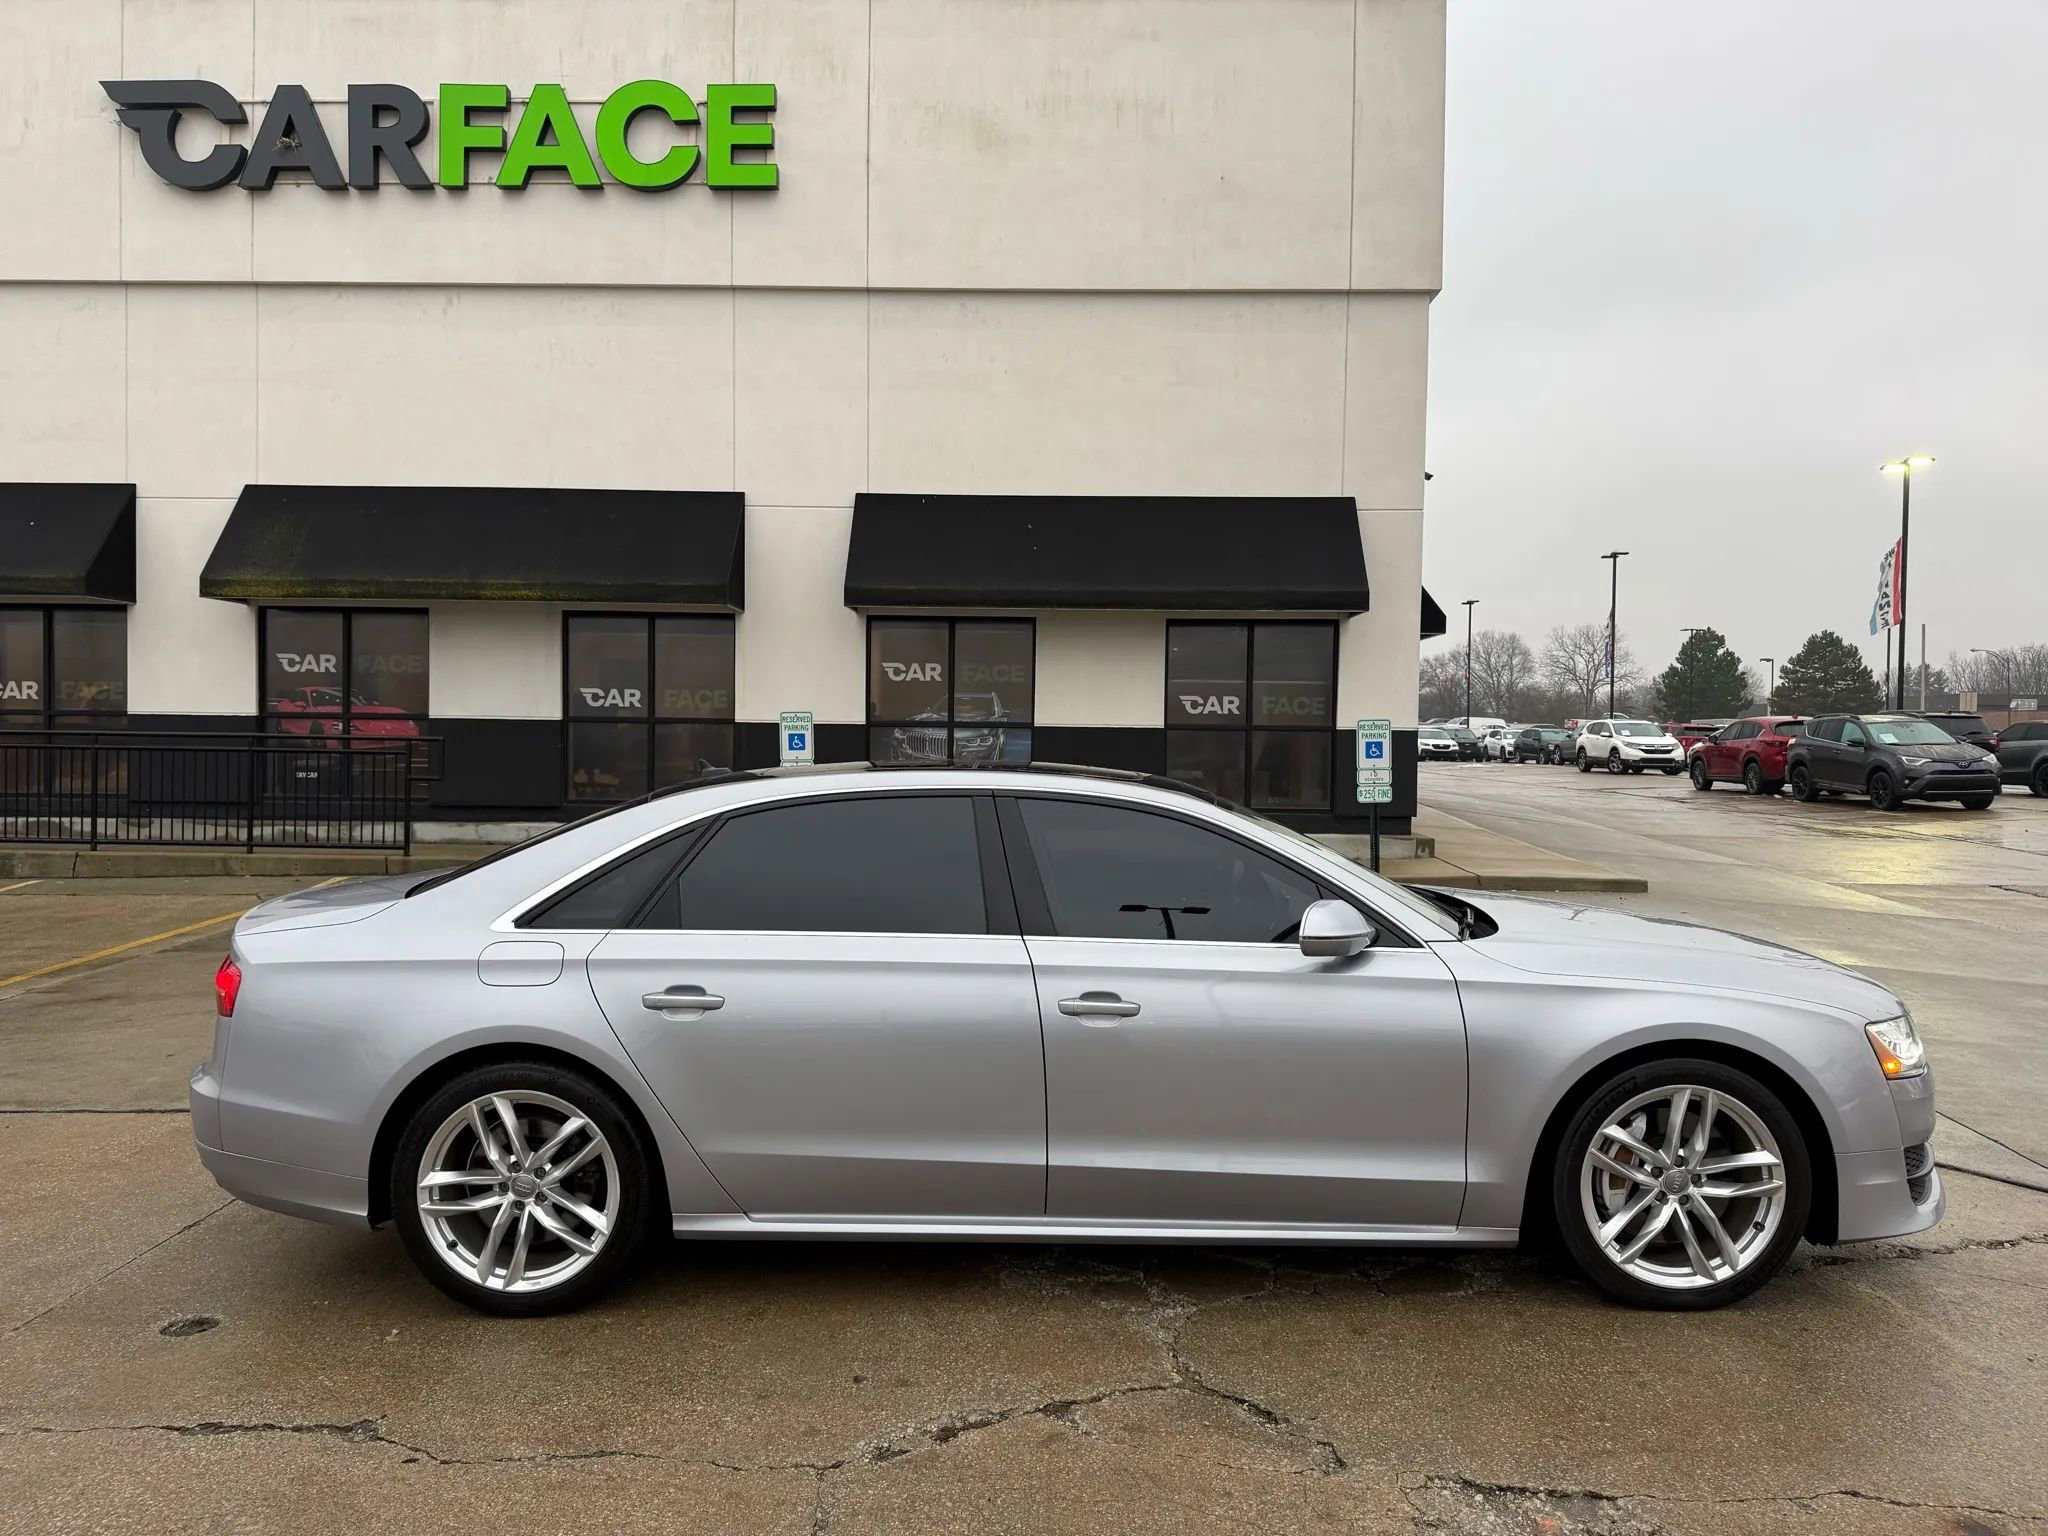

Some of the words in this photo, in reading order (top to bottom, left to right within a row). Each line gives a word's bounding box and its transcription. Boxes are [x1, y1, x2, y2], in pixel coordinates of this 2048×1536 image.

[99, 79, 779, 193] CARFACE
[276, 653, 337, 673] CAR
[358, 653, 424, 674] FACE
[881, 662, 943, 682] CAR
[962, 664, 1025, 683] FACE
[0, 681, 39, 699] AR
[579, 687, 642, 708] CAR
[664, 689, 729, 708] FACE
[1179, 695, 1241, 715] CAR
[1262, 697, 1326, 716] FACE
[1361, 732, 1387, 740] PARKING
[1359, 789, 1376, 799] $250
[1377, 789, 1391, 799] FINE
